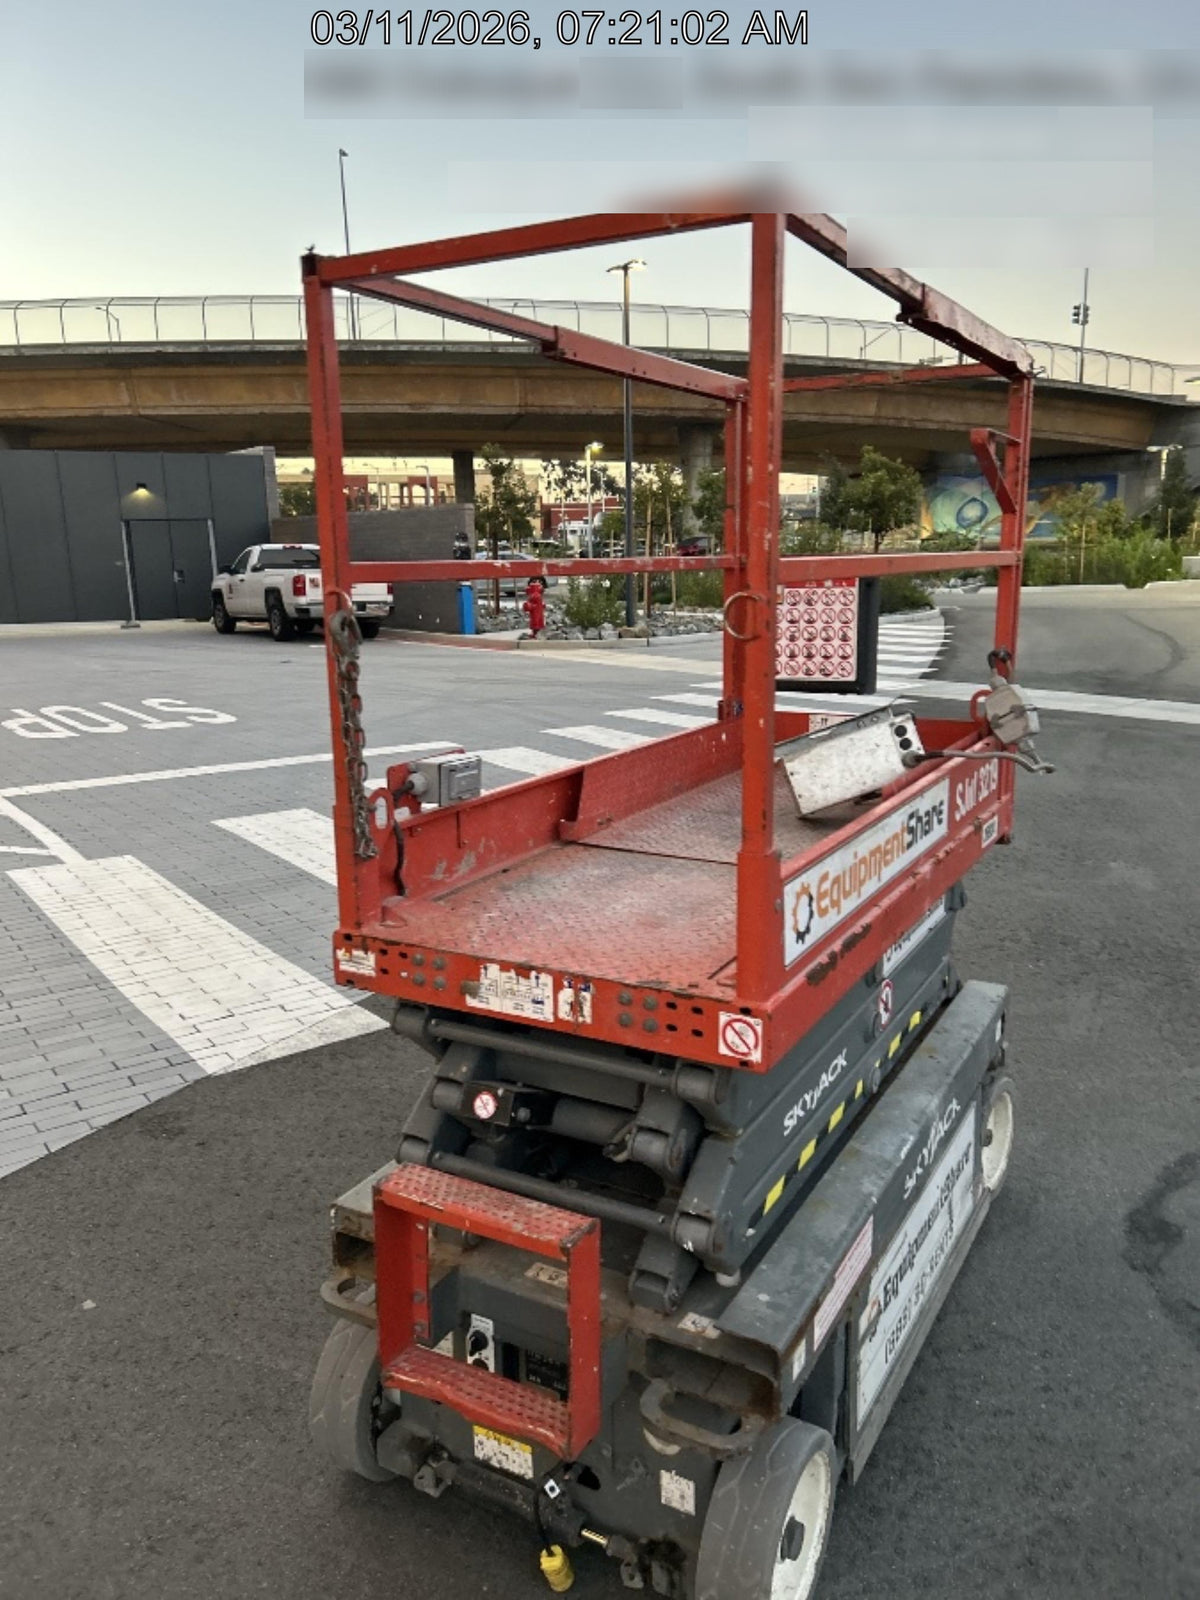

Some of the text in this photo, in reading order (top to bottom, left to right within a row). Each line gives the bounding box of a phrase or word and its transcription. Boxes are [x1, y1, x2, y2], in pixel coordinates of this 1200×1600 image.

[1, 697, 237, 739] STOP
[816, 799, 945, 919] EquipmentShare
[783, 1047, 848, 1136] SKYJACK
[903, 1097, 961, 1200] SKYJACK
